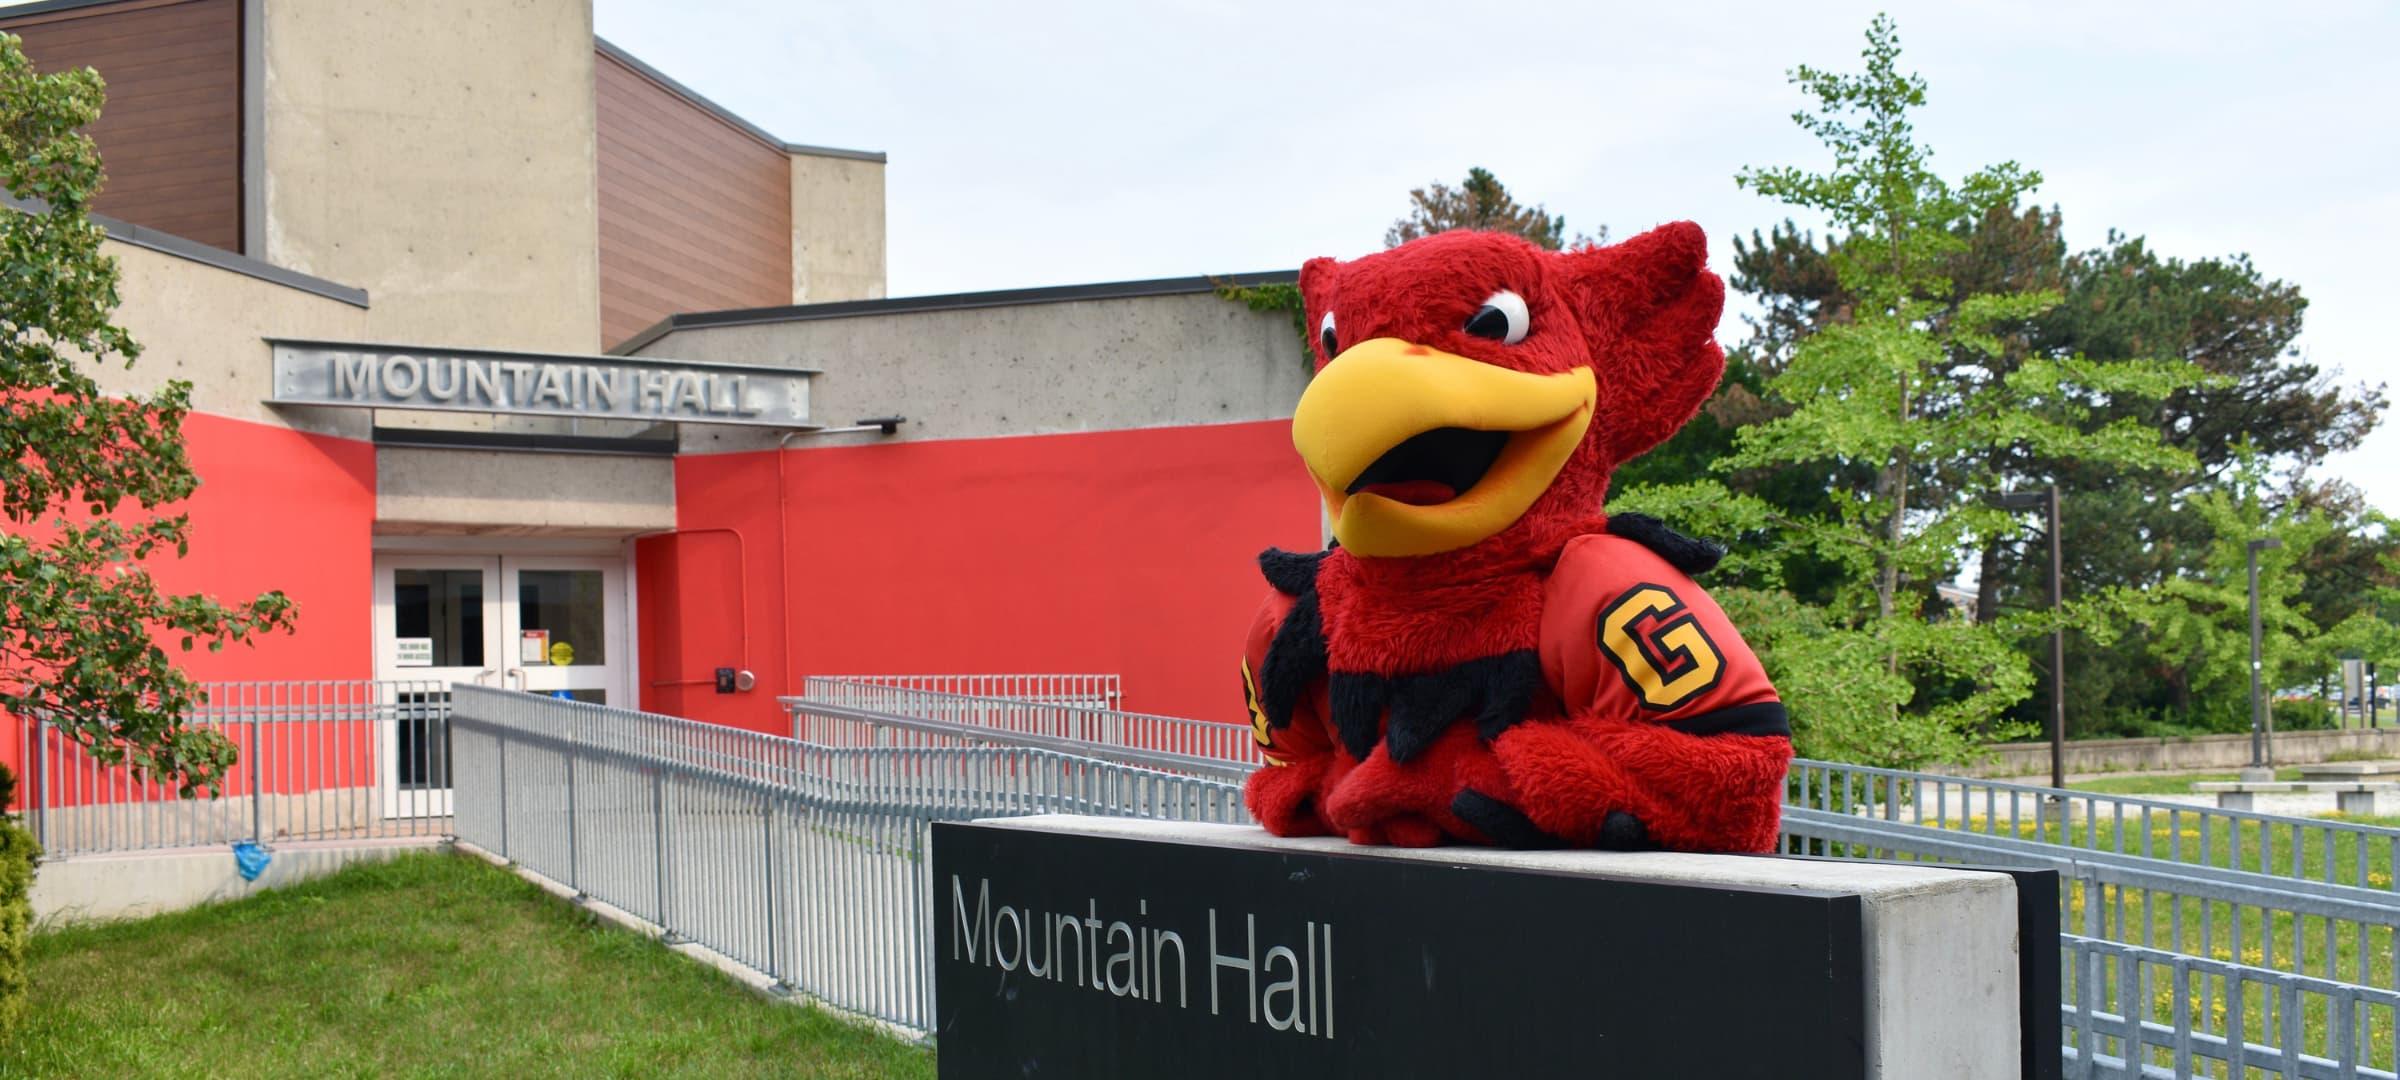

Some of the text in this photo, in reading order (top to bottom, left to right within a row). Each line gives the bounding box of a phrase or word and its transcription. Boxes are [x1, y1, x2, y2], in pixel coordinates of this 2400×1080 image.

[334, 352, 761, 414] MOUNTAIN HALL
[1598, 582, 1727, 712] G
[952, 874, 1334, 1039] Mountain Hall
